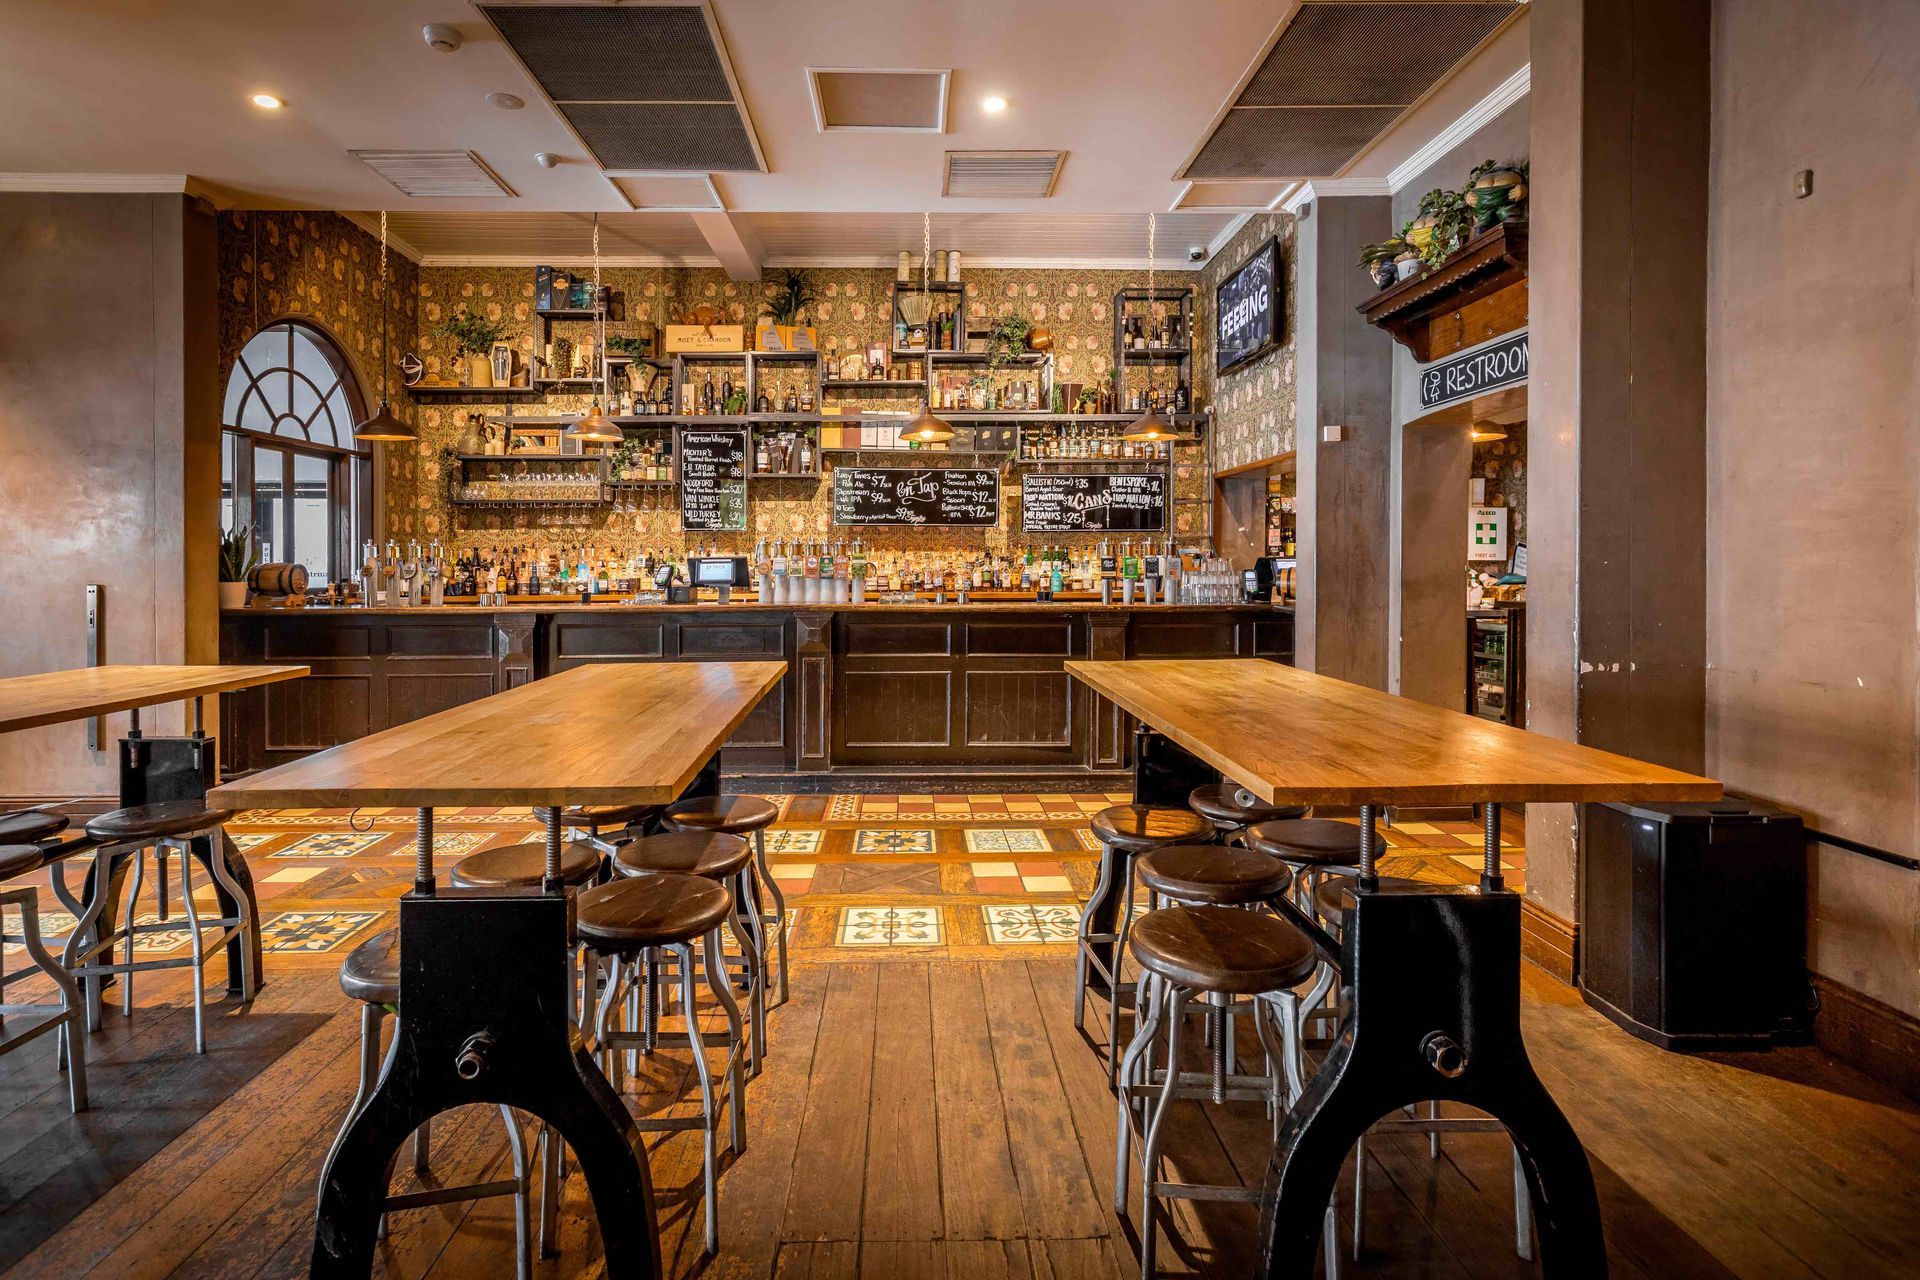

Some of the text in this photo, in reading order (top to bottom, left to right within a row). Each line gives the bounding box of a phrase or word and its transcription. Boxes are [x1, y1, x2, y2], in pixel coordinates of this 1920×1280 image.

[687, 433, 734, 448] American Whiskey
[731, 450, 743, 462] $18
[695, 463, 715, 472] TAYLOR
[731, 464, 742, 477] $18
[684, 479, 714, 488] WOODFORD
[837, 470, 852, 480] Easy
[851, 470, 871, 480] Times
[871, 472, 886, 488] $7
[897, 472, 939, 499] On Tap
[944, 471, 967, 479] Fixation
[976, 472, 987, 487] $9
[1026, 477, 1052, 486] BALLISTIC
[1075, 478, 1089, 489] $35
[1109, 476, 1148, 487] BENTSPOKE
[730, 483, 743, 495] $20
[958, 488, 972, 497] Hops
[972, 489, 988, 503] $12
[684, 493, 743, 510] VAN WINKLE $35
[871, 490, 883, 504] $9
[1024, 493, 1038, 501] HOP
[1038, 493, 1064, 501] NATION
[1074, 489, 1112, 510] CANS
[1112, 493, 1163, 507] HOP NATION $16
[685, 510, 741, 523] WILD TURKEY $20
[969, 505, 986, 519] $12
[1063, 512, 1081, 524] $25
